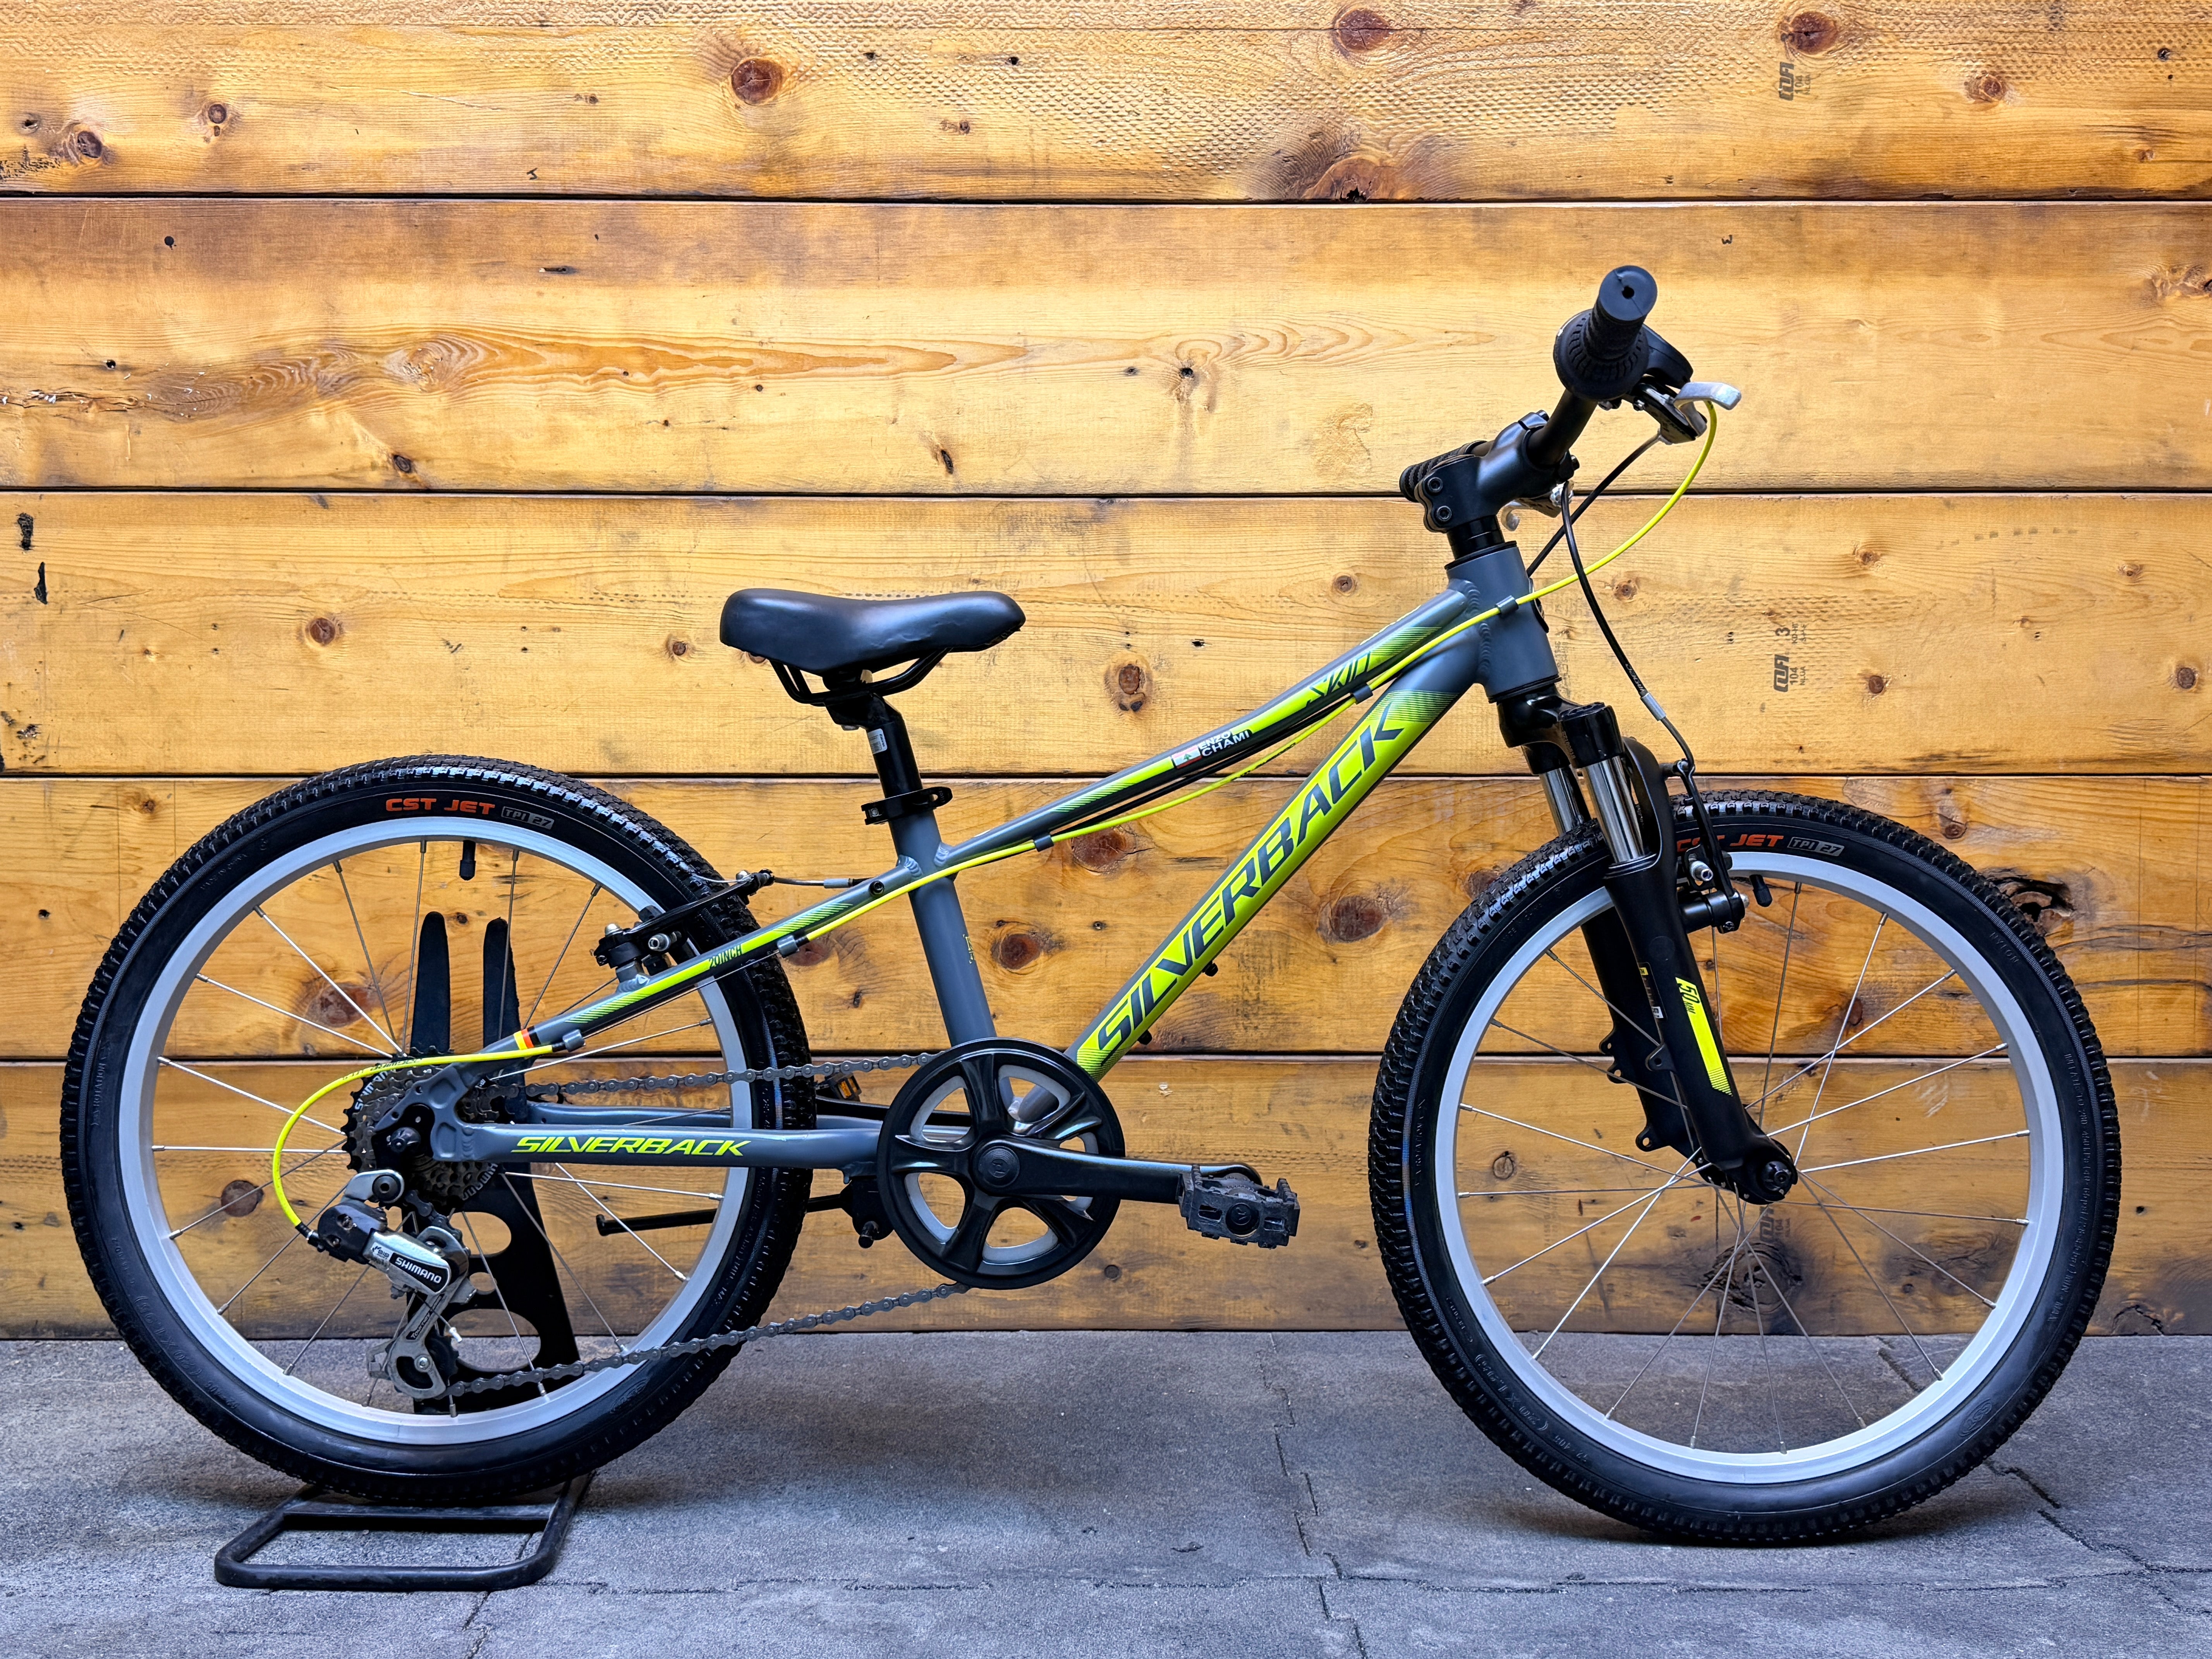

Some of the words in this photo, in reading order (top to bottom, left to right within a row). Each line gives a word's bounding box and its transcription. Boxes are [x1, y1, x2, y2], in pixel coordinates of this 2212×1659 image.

[1795, 75, 1803, 94] 104
[1775, 627, 1790, 636] 3
[1790, 667, 1798, 685] 104
[1200, 731, 1230, 749] ENZO
[1202, 730, 1250, 757] CHAMI
[386, 798, 436, 812] CST
[444, 800, 495, 814] JET
[505, 809, 526, 822] TPI
[532, 816, 552, 827] 27
[1729, 834, 1784, 847] JET
[1792, 839, 1816, 850] TPI
[1820, 844, 1839, 855] 27
[1098, 704, 1405, 1067] SILVERBACK
[510, 1137, 752, 1156] SILVERBACK
[1775, 1219, 1784, 1235] 104
[395, 1257, 441, 1284] SHIMANO
[411, 1311, 433, 1340] Tourney
